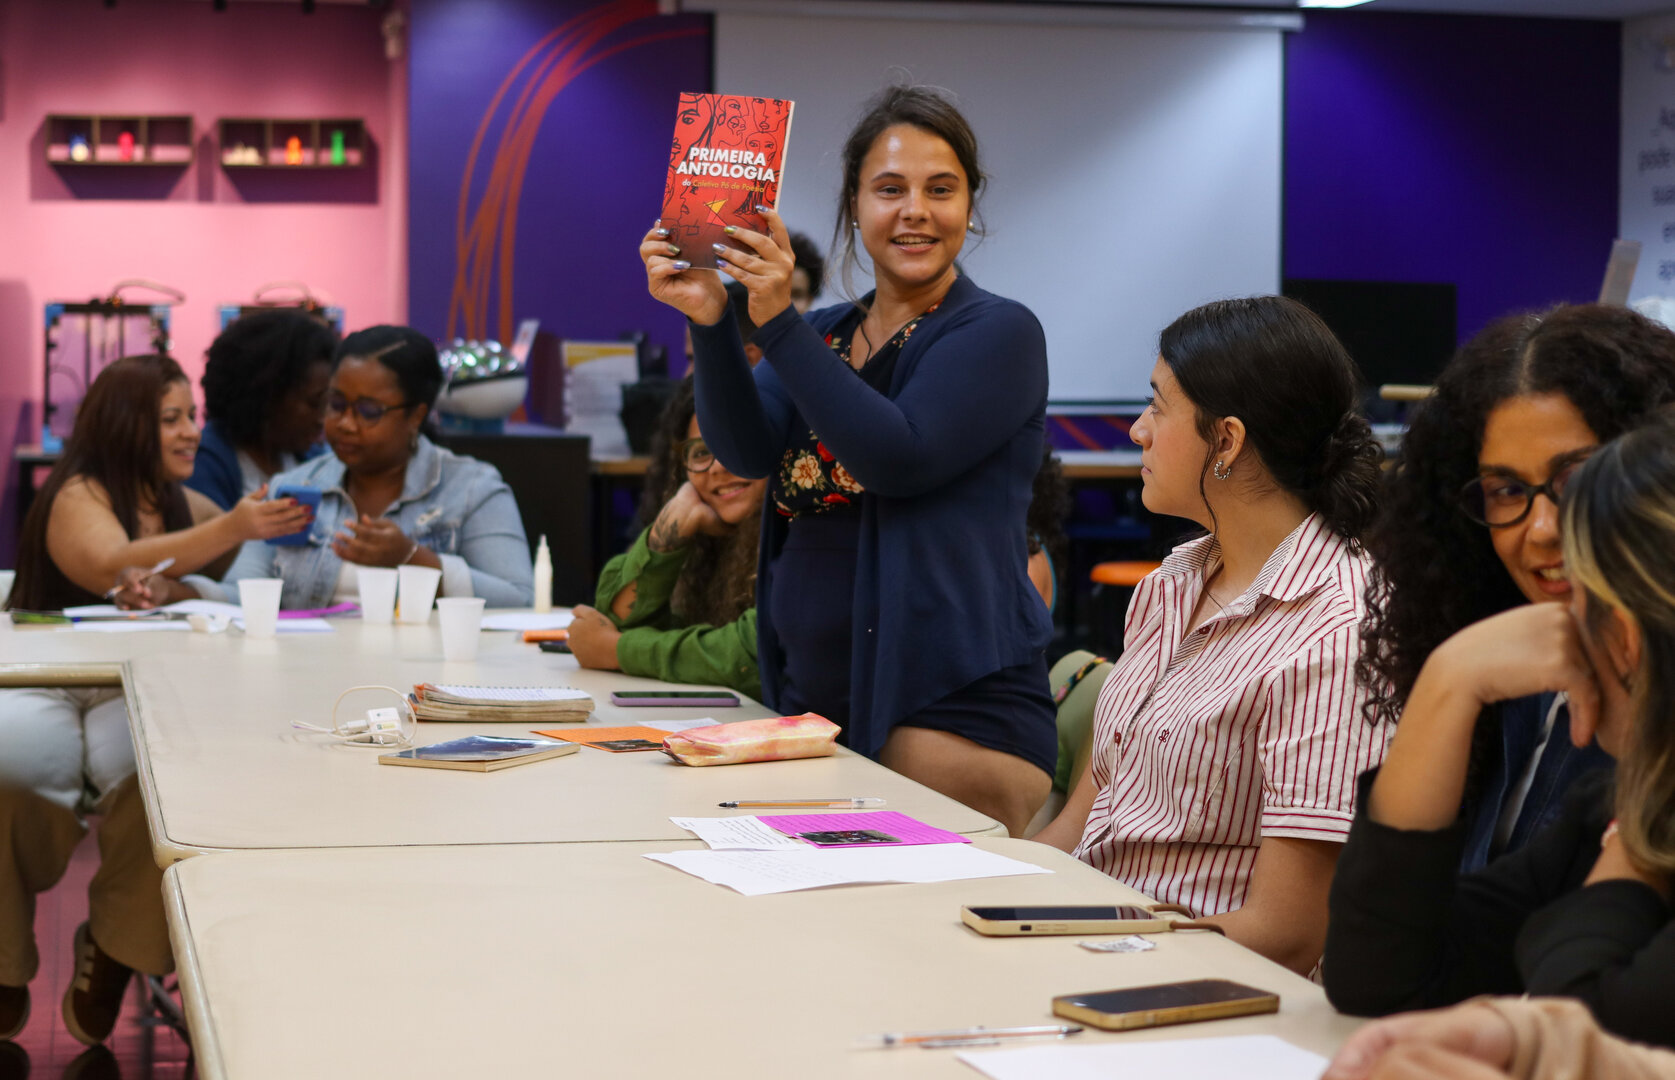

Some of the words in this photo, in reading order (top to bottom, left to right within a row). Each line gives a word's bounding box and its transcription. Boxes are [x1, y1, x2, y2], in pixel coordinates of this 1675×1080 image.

[689, 147, 766, 166] PRIMEIRA
[676, 161, 775, 182] ANTOLOGIA
[731, 182, 741, 190] de
